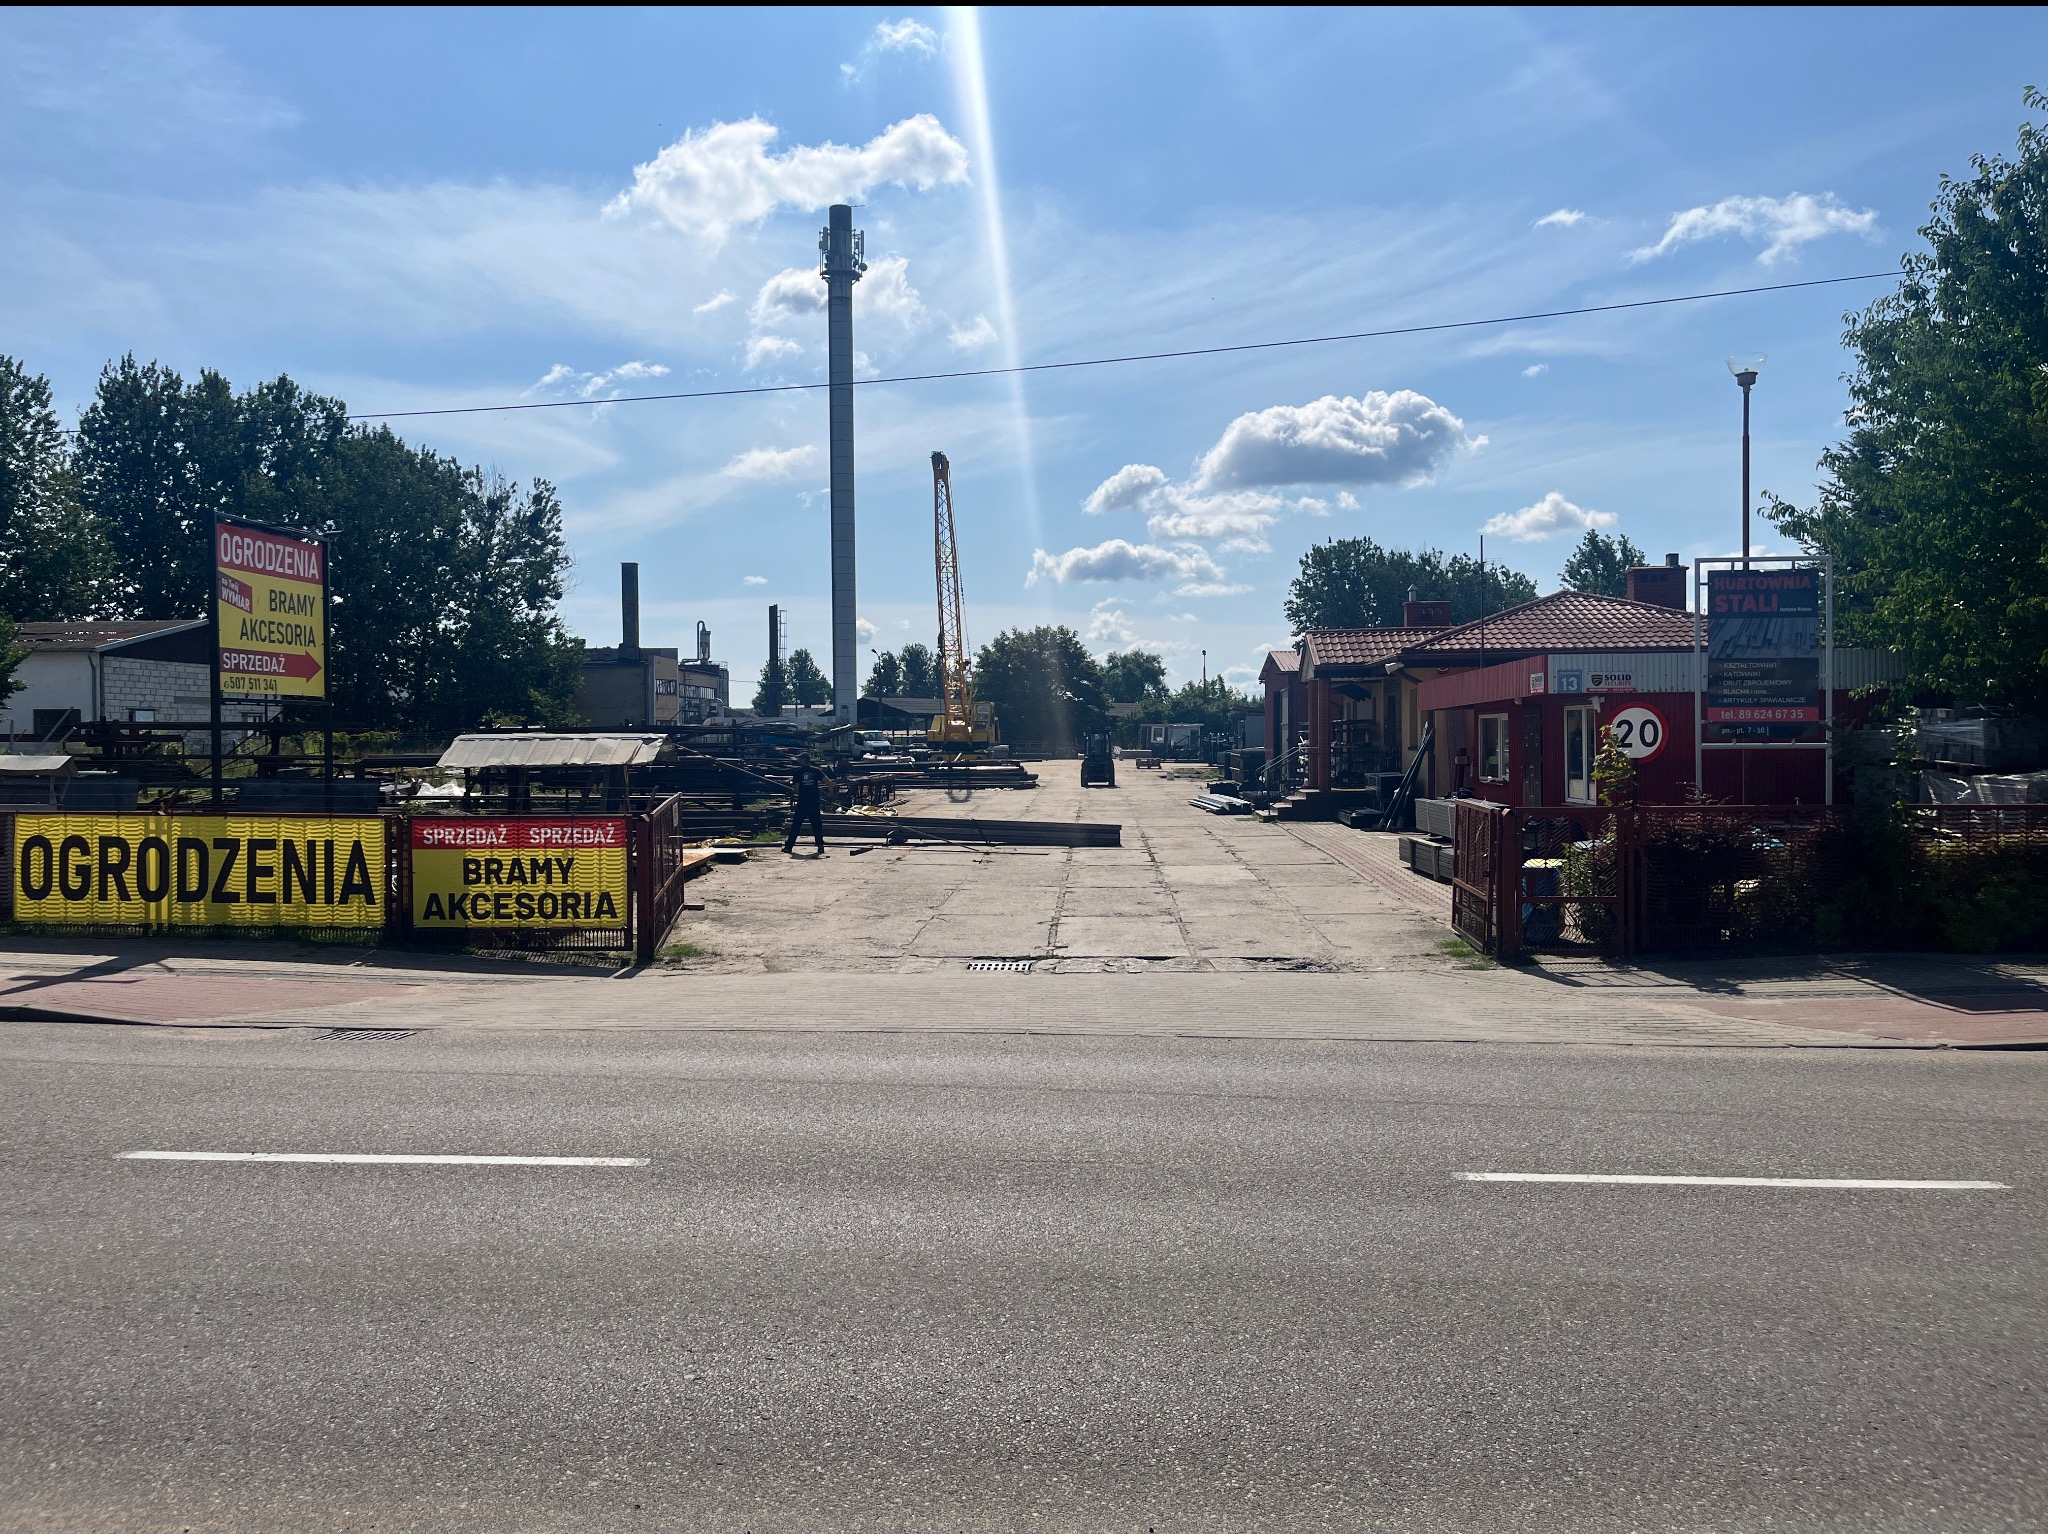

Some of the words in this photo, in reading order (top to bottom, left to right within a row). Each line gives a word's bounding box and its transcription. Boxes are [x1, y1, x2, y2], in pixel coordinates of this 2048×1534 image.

[220, 533, 319, 580] OGRODZENIA
[1714, 576, 1811, 590] HURTOWNIA
[221, 586, 250, 612] WYMIAR
[269, 589, 316, 617] BRAMY
[1715, 594, 1778, 612] STALI
[240, 617, 316, 648] AKCESORIA
[223, 653, 286, 673] SPRZEDAŻ
[229, 676, 246, 690] 507
[248, 678, 262, 691] 511
[263, 679, 278, 692] 341
[1561, 677, 1578, 691] 13
[1721, 711, 1736, 719] tel.
[1739, 710, 1751, 719] 89
[1754, 710, 1772, 719] 624
[1775, 710, 1788, 719] 67
[1790, 710, 1803, 718] 35
[1616, 719, 1659, 748] 20
[423, 824, 508, 845] SPRZEDAŻ
[529, 823, 616, 844] SPRZEDAŻ
[20, 834, 377, 906] OGRODZENIA
[463, 857, 575, 886] BRAMY
[422, 891, 618, 921] AKCESORIA
